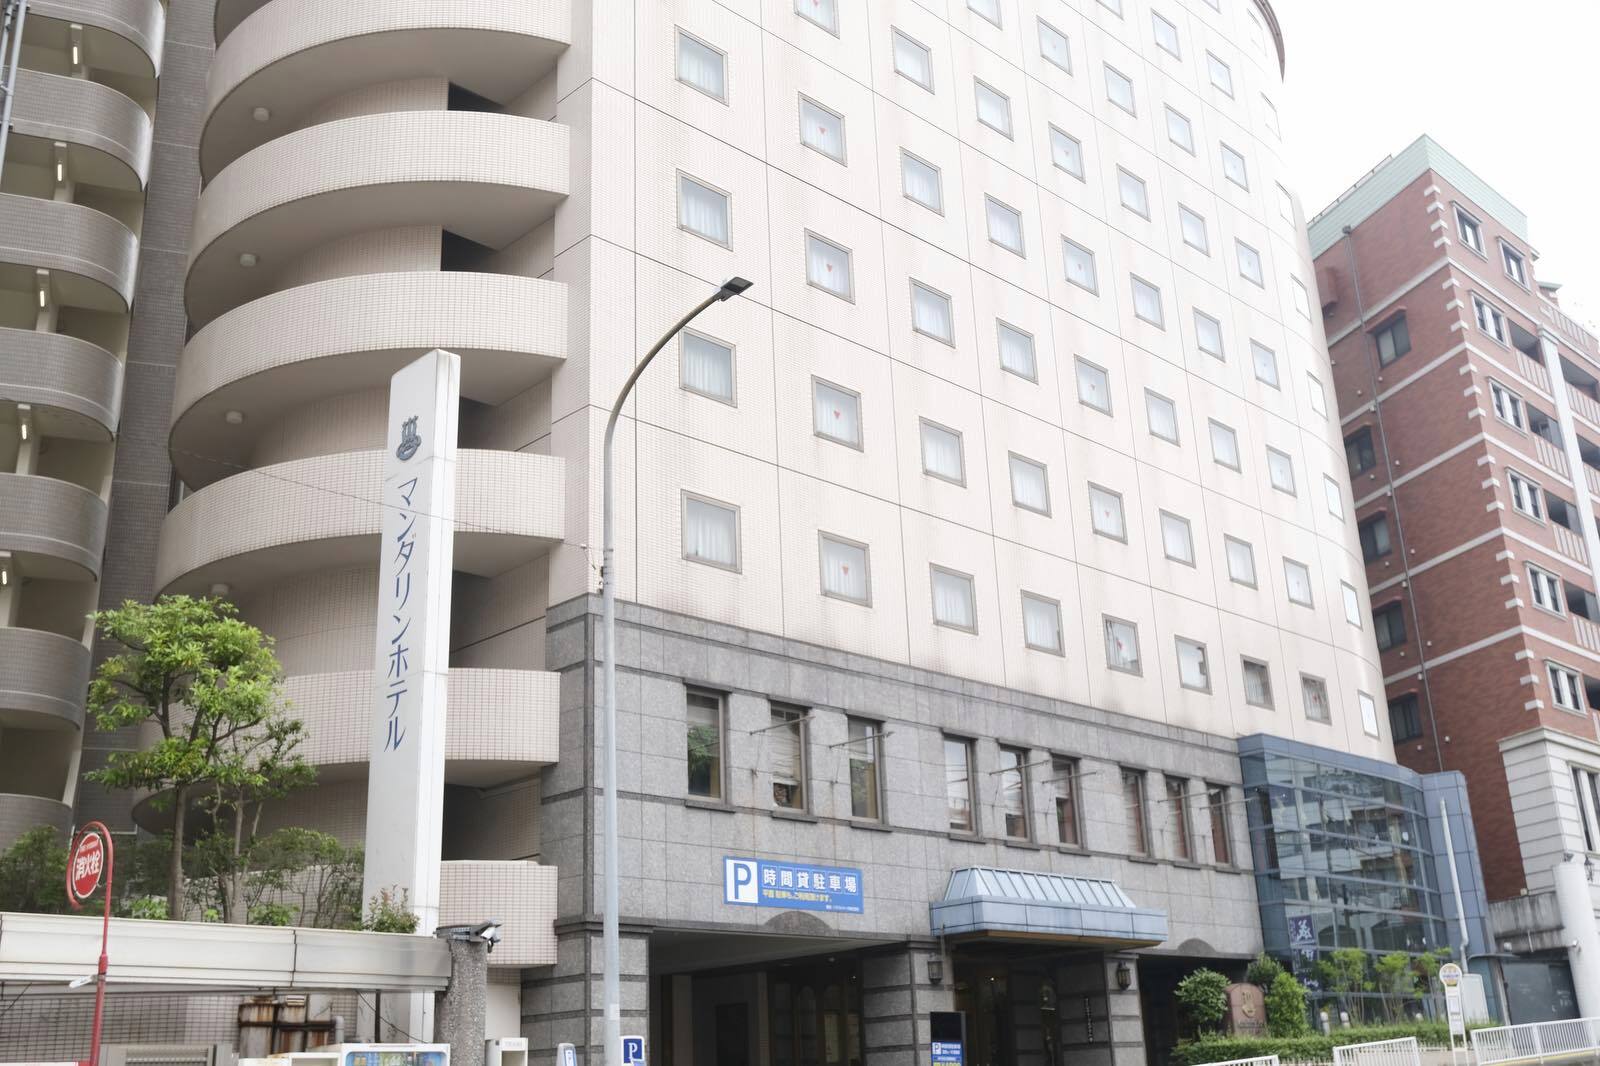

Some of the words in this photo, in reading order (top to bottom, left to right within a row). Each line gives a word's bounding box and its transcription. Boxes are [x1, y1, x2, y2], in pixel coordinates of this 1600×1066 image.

[384, 477, 418, 752] マンダリンホテル
[76, 850, 100, 881] 消火栓
[763, 869, 857, 893] 時間貸駐車場
[734, 863, 751, 900] P
[628, 1042, 638, 1060] P
